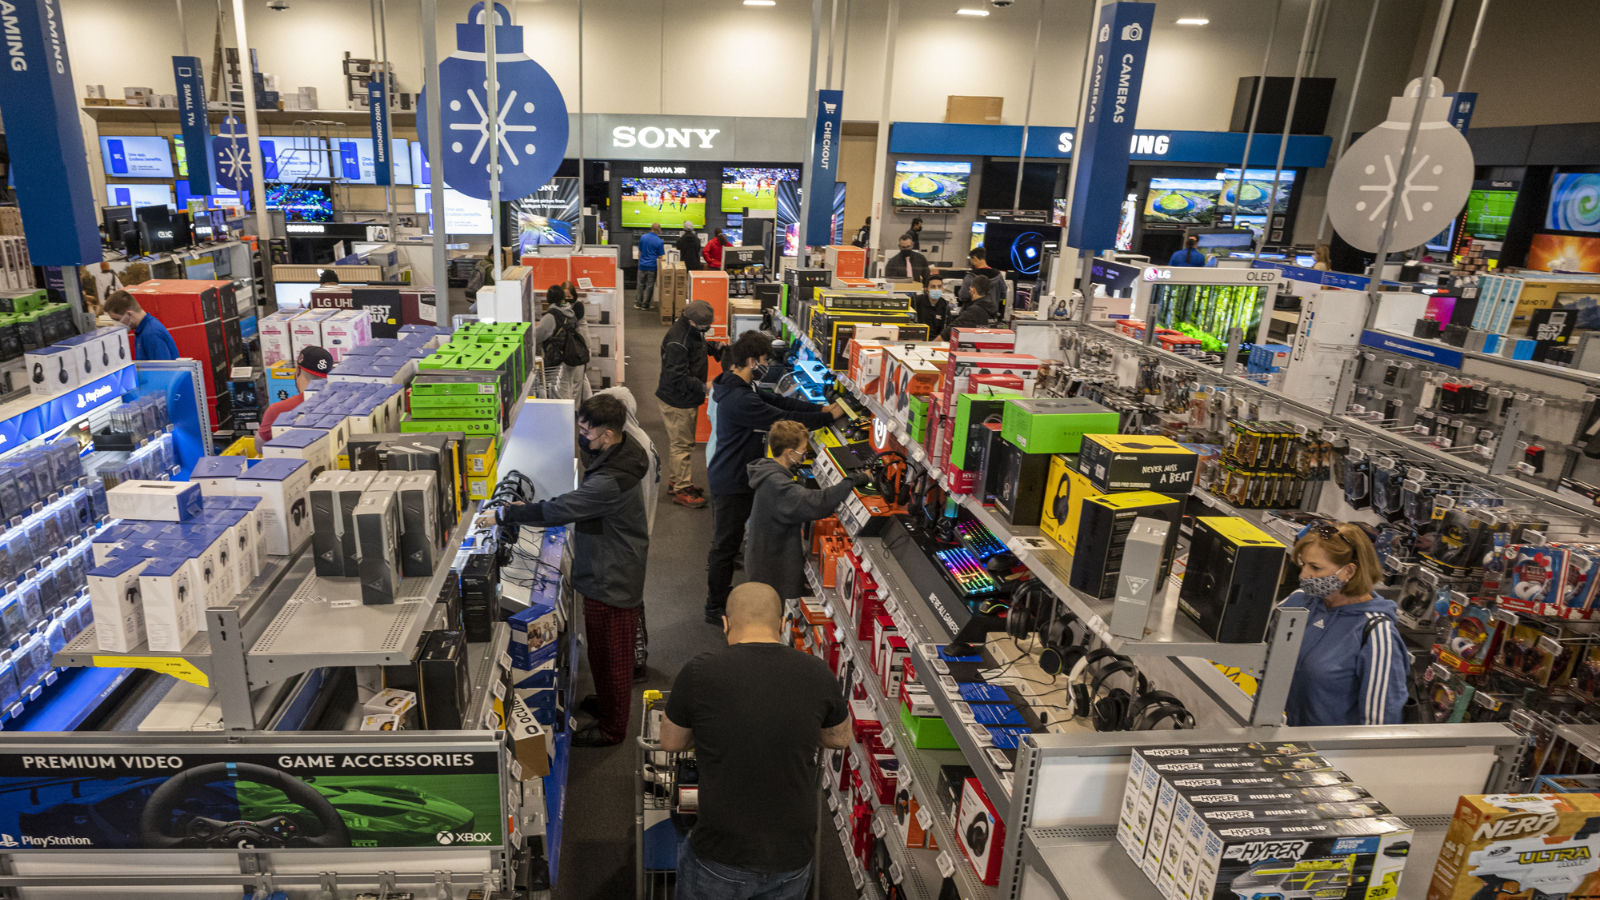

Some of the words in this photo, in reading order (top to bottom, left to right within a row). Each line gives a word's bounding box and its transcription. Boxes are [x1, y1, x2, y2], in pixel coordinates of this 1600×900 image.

[1089, 54, 1104, 122] CAMERAS
[1113, 54, 1134, 124] CAMERAS
[183, 84, 193, 110] SMALL
[376, 122, 385, 162] COMPONENTS
[613, 126, 720, 148] SONY
[821, 121, 832, 170] CHECKOUT
[1158, 270, 1171, 279] LG
[1246, 272, 1275, 282] OLED
[316, 298, 332, 307] LG
[362, 305, 391, 314] BEST
[1537, 324, 1566, 333] BEST
[1537, 332, 1560, 340] BUY
[1142, 465, 1163, 474] NEVER
[1164, 464, 1178, 472] MISS
[1160, 474, 1166, 483] A
[1170, 471, 1193, 483] BEAT
[938, 605, 947, 617] ALL
[943, 612, 960, 635] GAMERS
[1153, 748, 1189, 757] HYPER
[22, 756, 116, 769] PREMIUM
[120, 756, 183, 769] VIDEO
[278, 755, 335, 768] GAME
[341, 754, 474, 768] ACCESSORIES
[1167, 763, 1203, 771] HYPER
[1184, 778, 1222, 787] HYPER
[1201, 794, 1239, 803] HYPER
[1215, 810, 1254, 820] HYPER
[1230, 827, 1271, 837] HYPER
[1472, 814, 1558, 841] NERF
[21, 836, 92, 848] PlayStation
[456, 832, 492, 843] XBOX
[1241, 840, 1304, 862] HYPER
[1518, 846, 1592, 865] ULTRA
